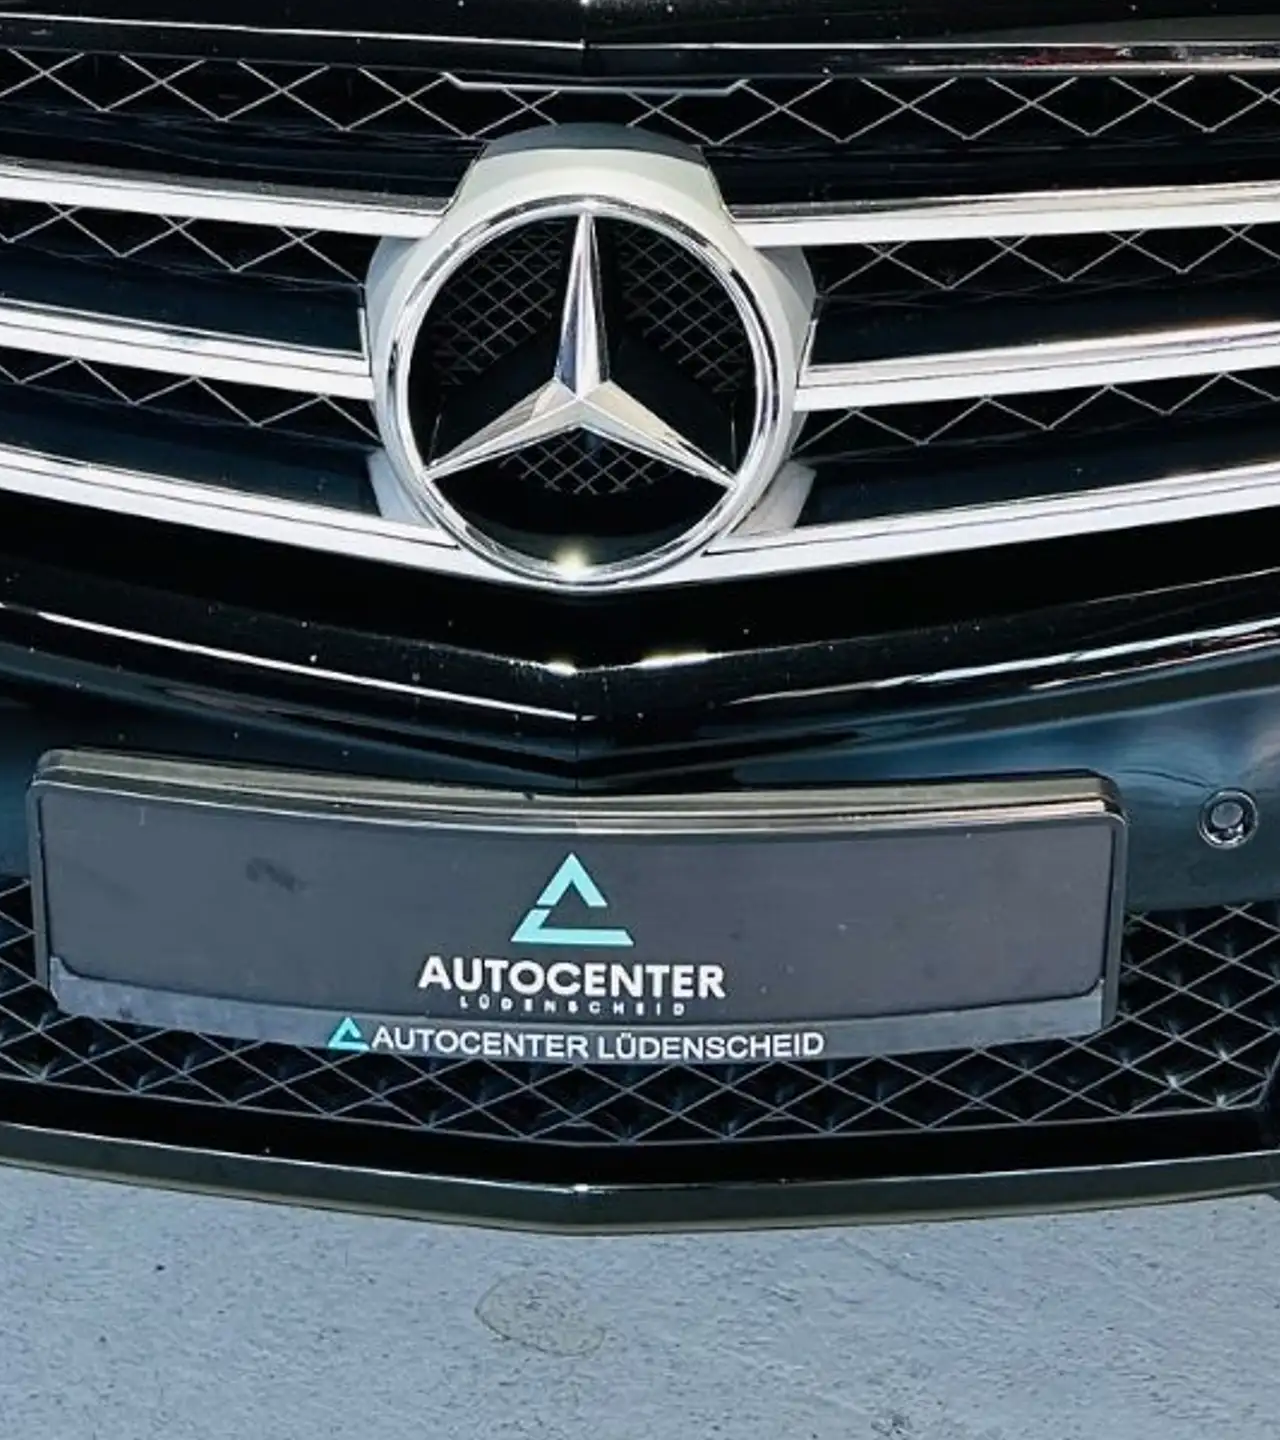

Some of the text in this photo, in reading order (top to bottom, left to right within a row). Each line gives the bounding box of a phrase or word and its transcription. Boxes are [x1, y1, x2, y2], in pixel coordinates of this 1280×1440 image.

[417, 955, 726, 1000] AUTOCENTER
[371, 1025, 824, 1060] AUTOCENTER LÜDENSCHEID
